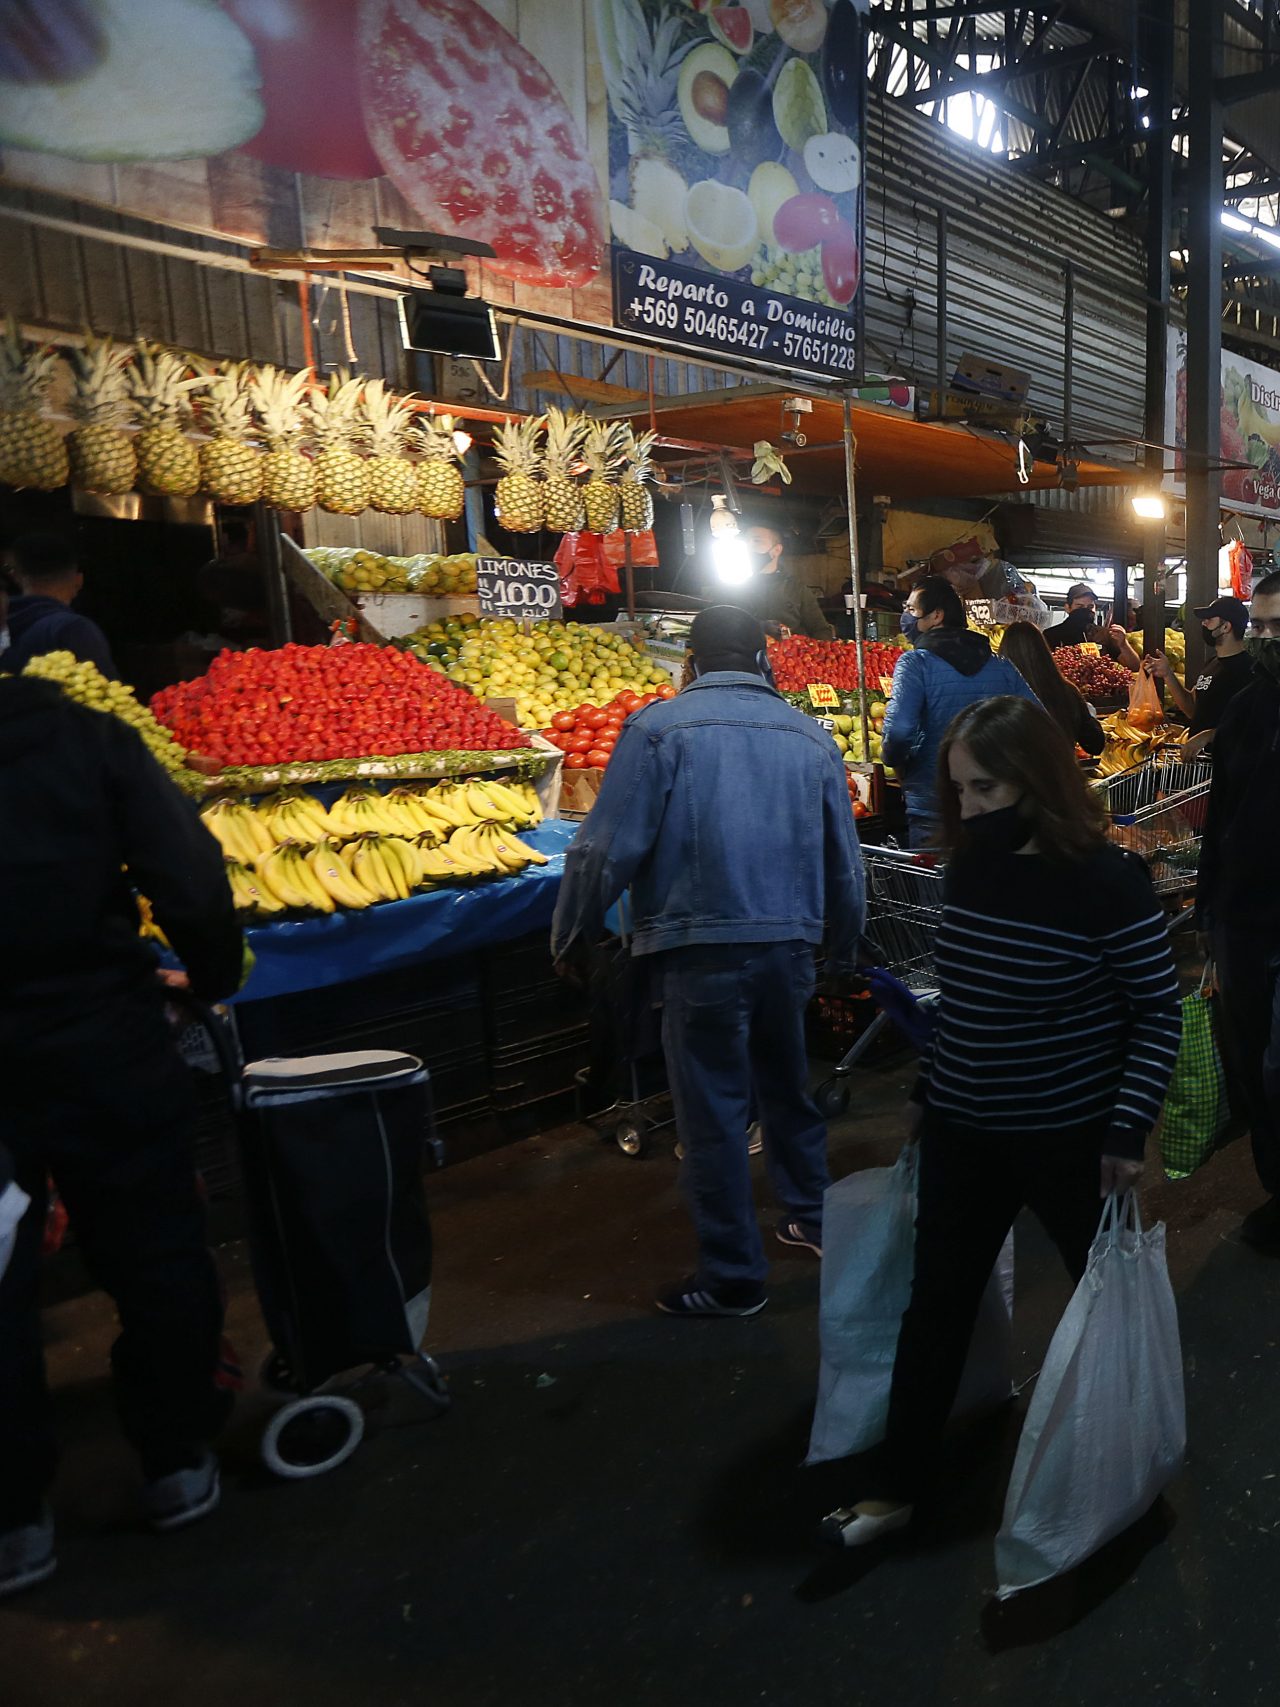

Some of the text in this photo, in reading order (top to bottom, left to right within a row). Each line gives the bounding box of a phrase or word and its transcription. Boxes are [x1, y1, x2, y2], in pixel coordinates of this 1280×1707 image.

[638, 264, 856, 342] Reparto a Domicilio
[630, 297, 678, 329] +569
[684, 306, 769, 350] 50465427
[783, 331, 856, 371] 57651228
[1253, 480, 1275, 500] Vega
[477, 558, 559, 581] LIMONES
[496, 607, 516, 617] EL
